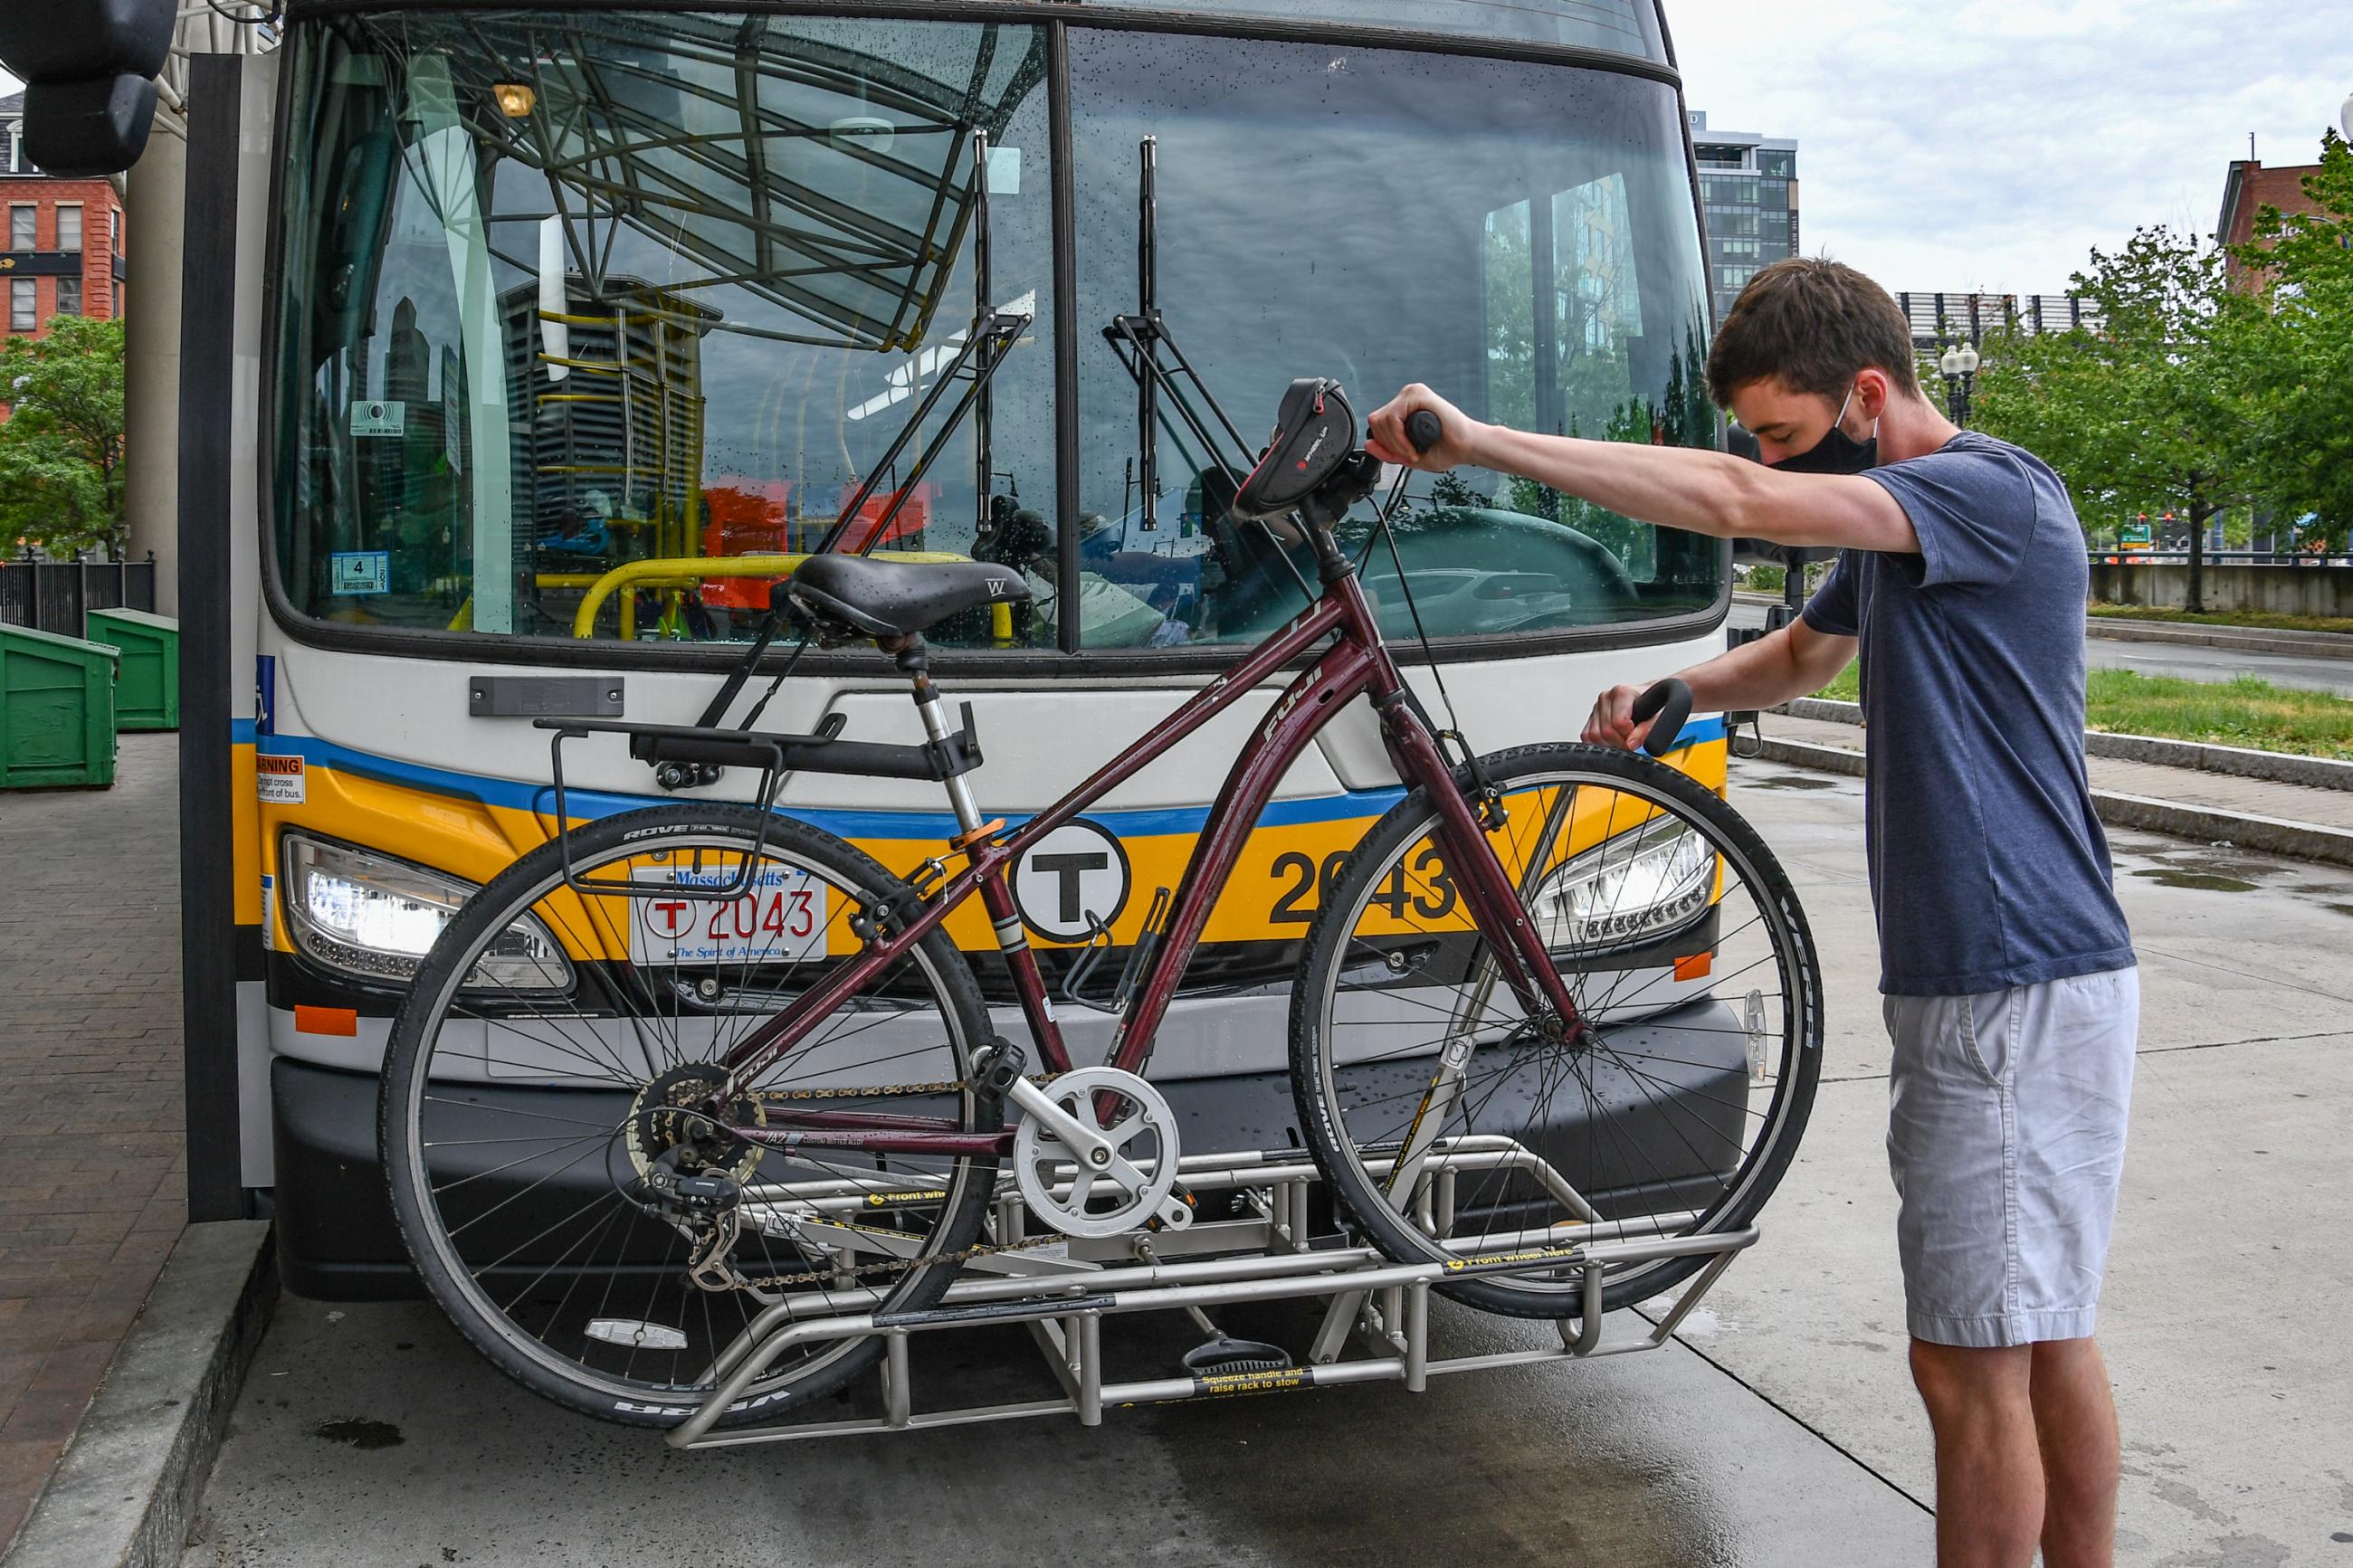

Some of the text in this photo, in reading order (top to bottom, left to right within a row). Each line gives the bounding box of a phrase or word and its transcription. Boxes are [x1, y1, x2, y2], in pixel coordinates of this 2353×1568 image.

[354, 561, 364, 575] 4
[1263, 666, 1322, 742] FUJI
[257, 758, 299, 773] ARNING
[274, 779, 293, 787] cross
[275, 788, 283, 798] of
[285, 788, 301, 798] bus.
[624, 825, 689, 841] ROVE
[677, 870, 783, 887] Massachsetts
[1032, 852, 1108, 923] T
[655, 891, 813, 939] T 2043
[676, 946, 693, 957] The
[696, 946, 724, 959] Spirt
[726, 946, 737, 959] of
[738, 1047, 777, 1086] FUJI
[1316, 1093, 1340, 1153] ROVE
[887, 1192, 921, 1202] Front
[1467, 1256, 1502, 1266] Front
[1504, 1252, 1541, 1263] wheel
[1542, 1249, 1573, 1259] here
[1202, 1367, 1303, 1385] Squeeze handle and
[1209, 1377, 1300, 1393] raise rack to stow
